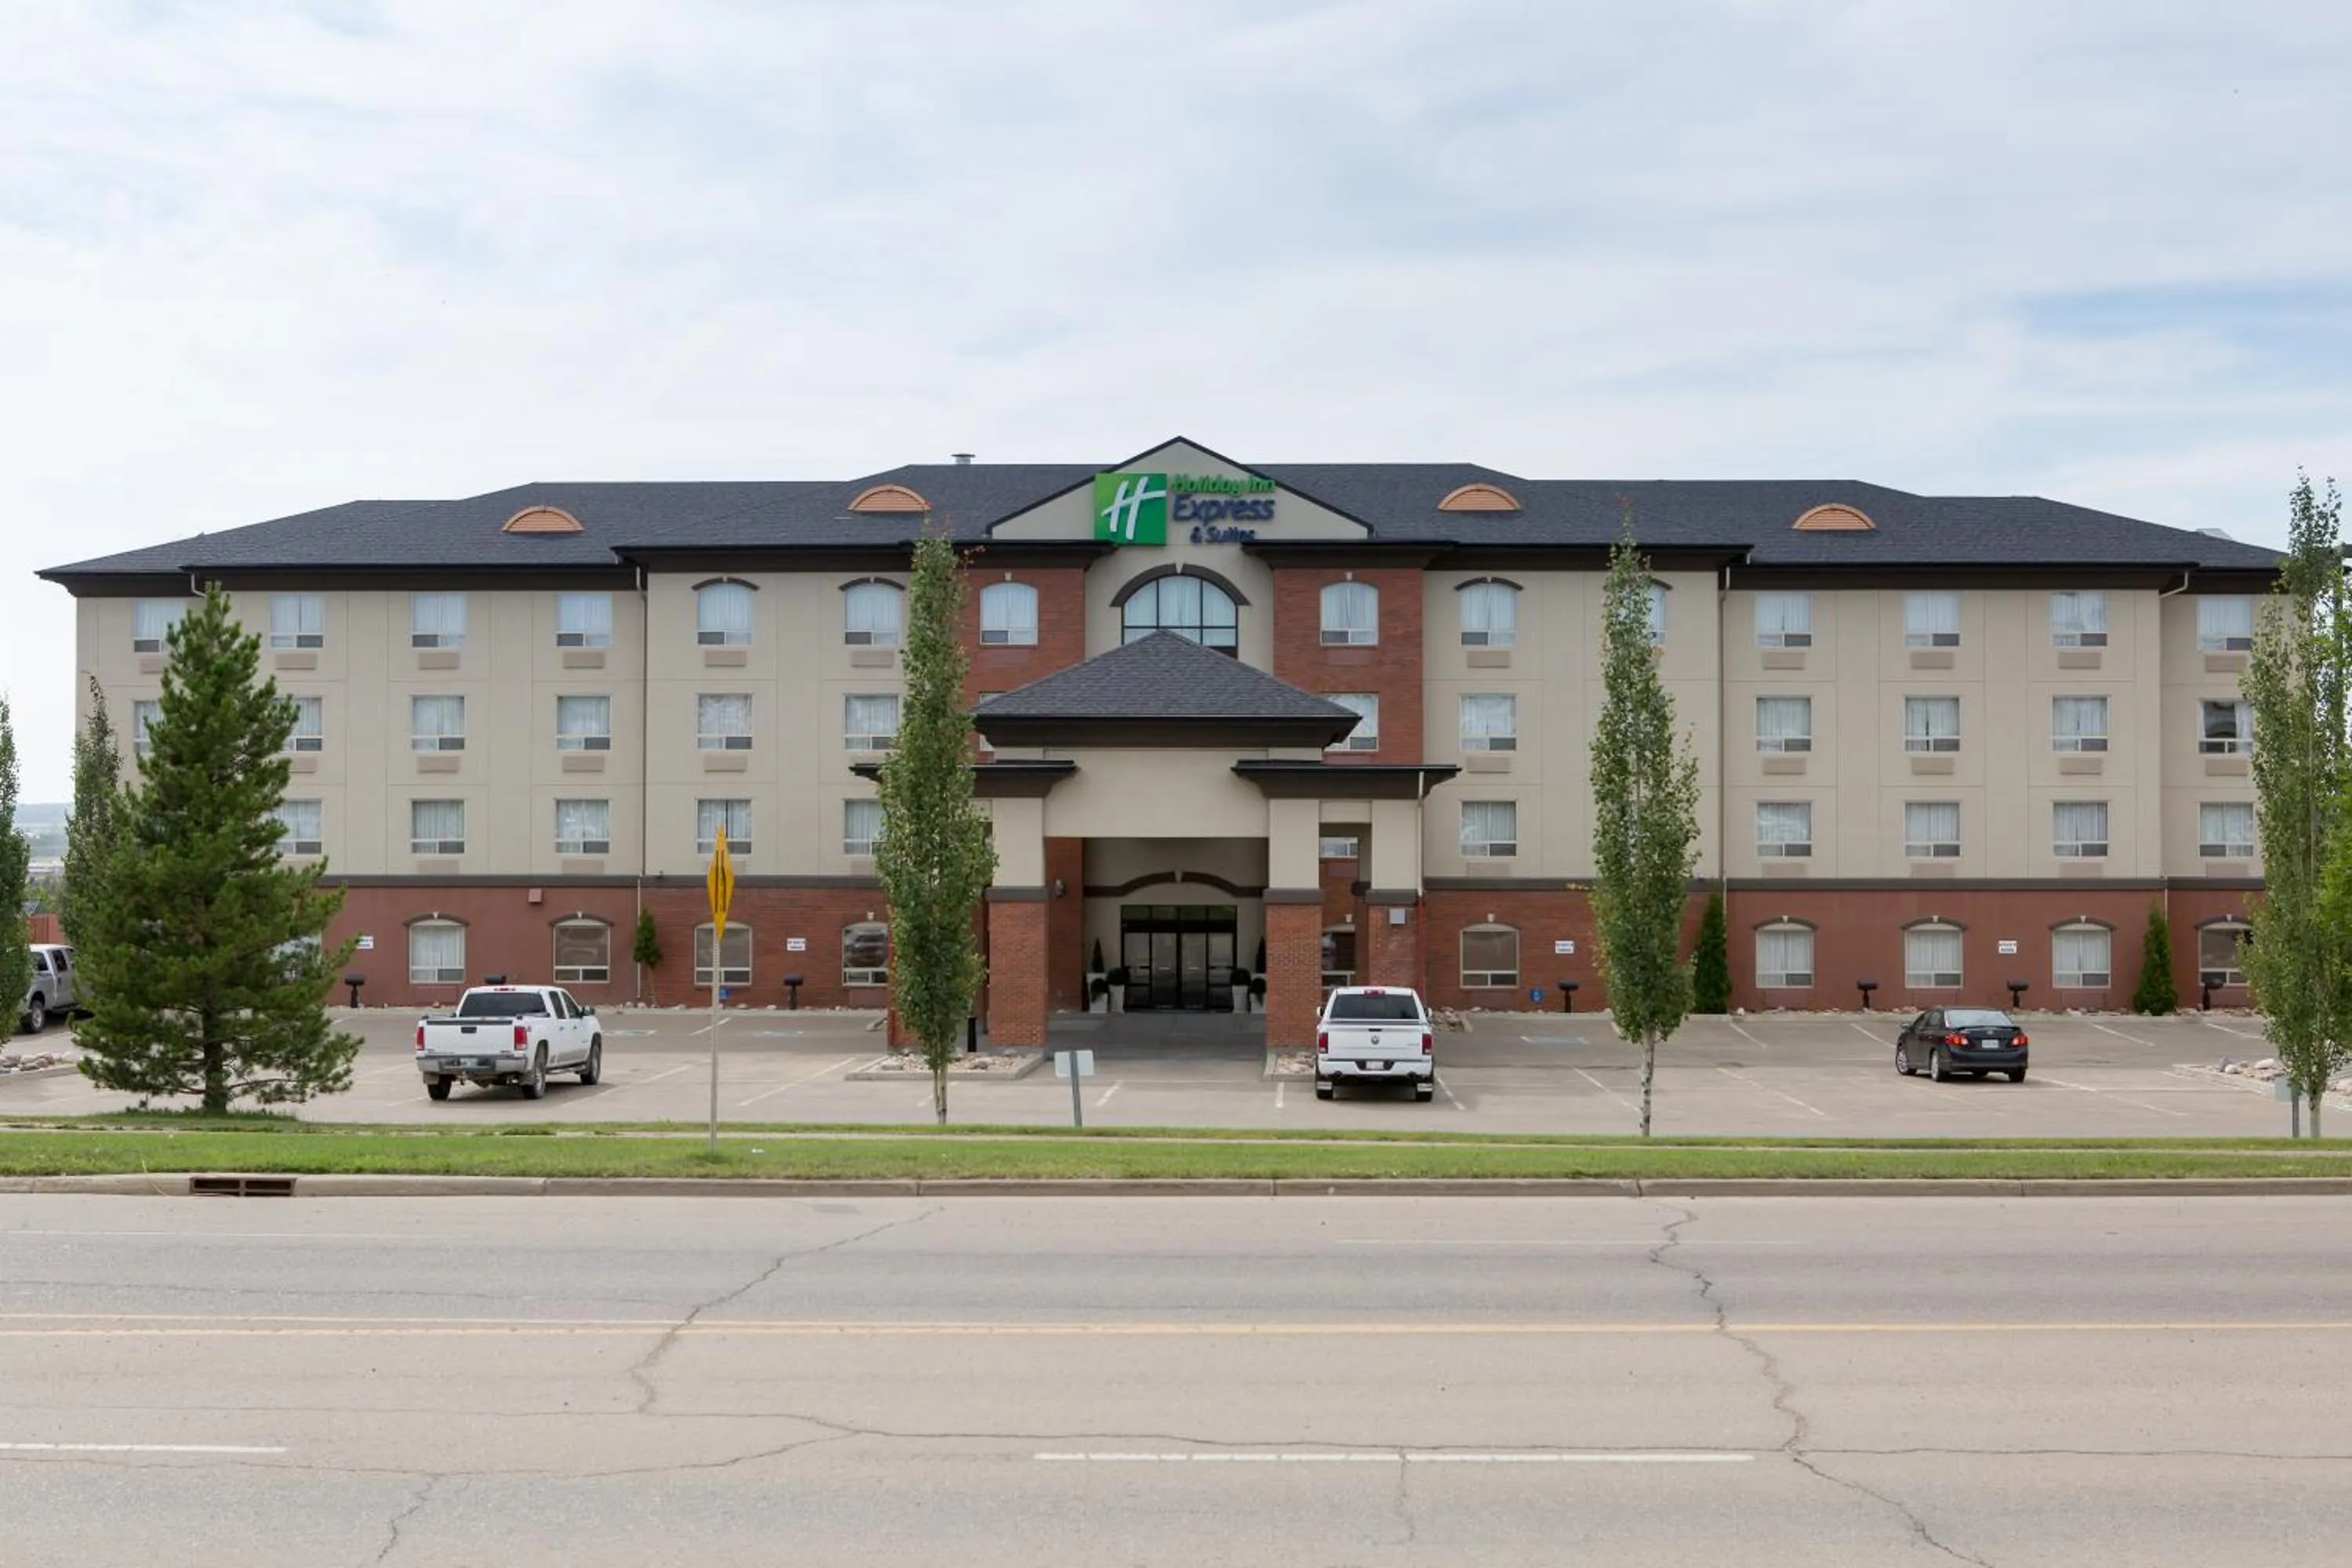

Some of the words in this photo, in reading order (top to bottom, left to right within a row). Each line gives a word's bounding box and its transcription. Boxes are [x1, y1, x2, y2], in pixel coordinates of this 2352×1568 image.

[1172, 474, 1242, 497] Holiday
[1248, 477, 1276, 493] Inn
[1173, 493, 1276, 525] Express
[1190, 526, 1203, 543] &
[1205, 526, 1256, 543] Suites
